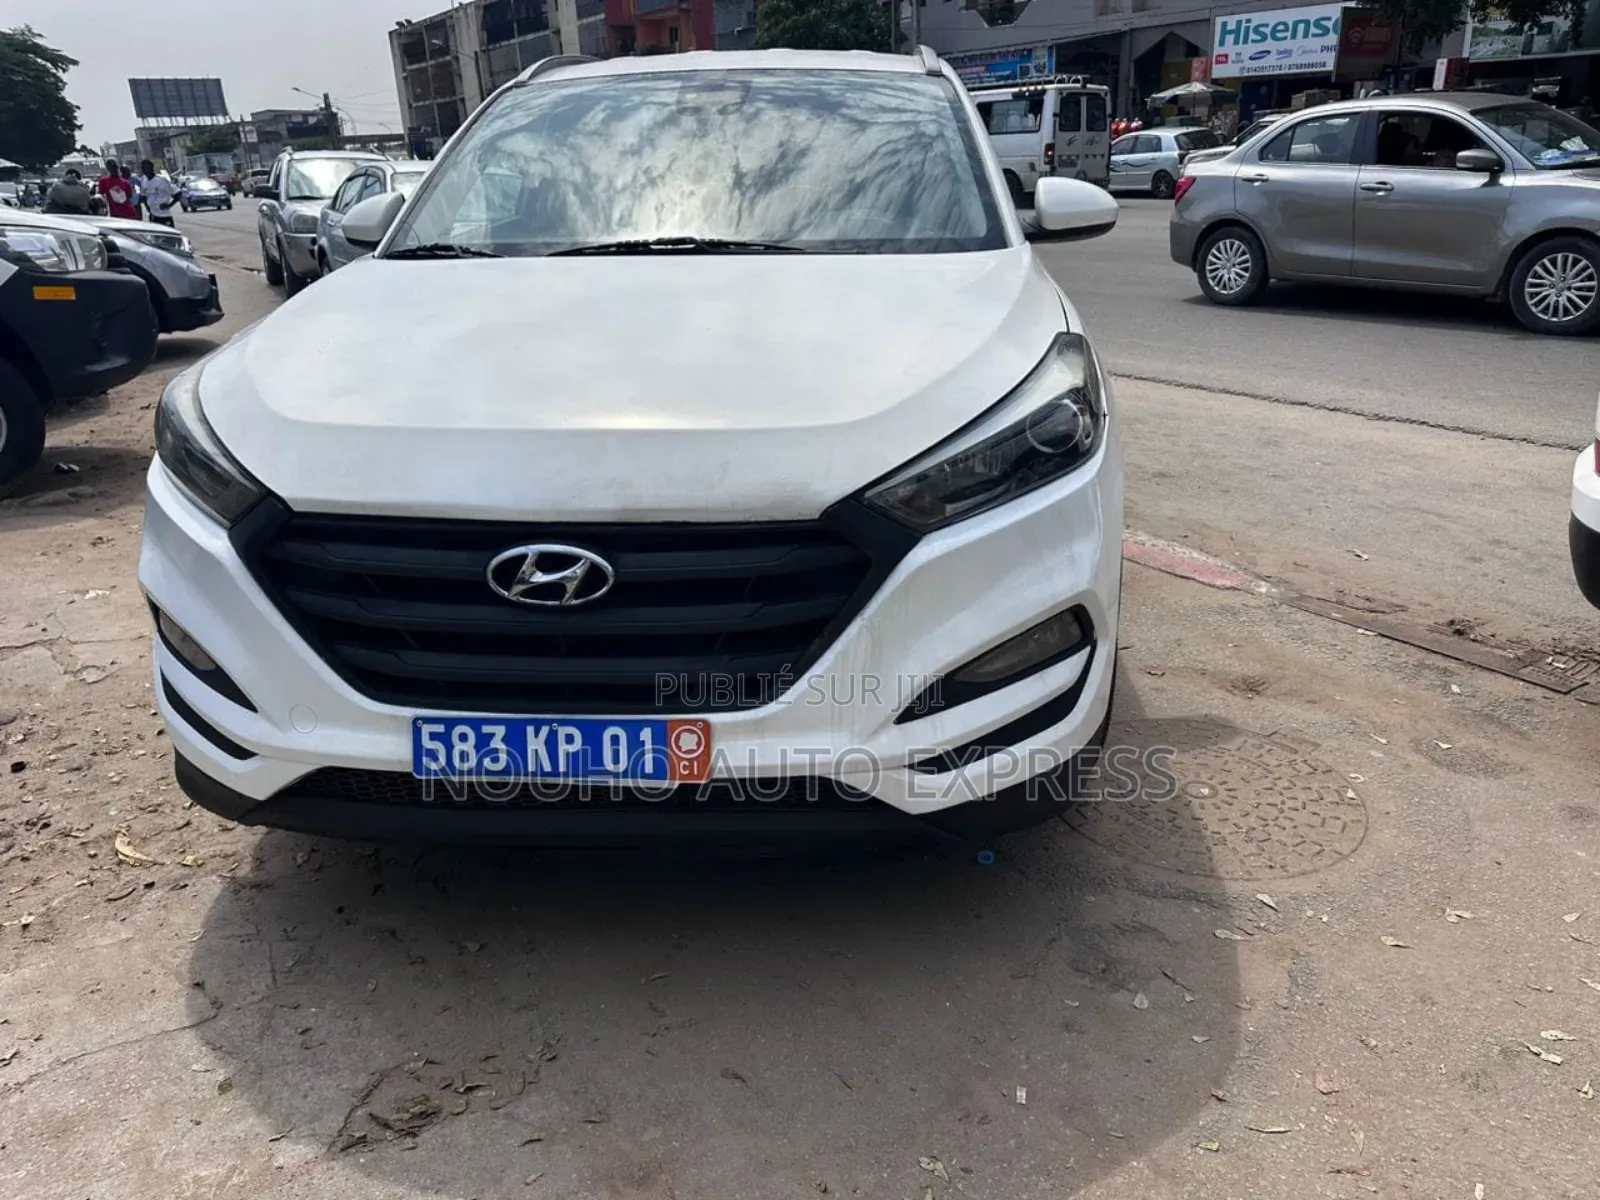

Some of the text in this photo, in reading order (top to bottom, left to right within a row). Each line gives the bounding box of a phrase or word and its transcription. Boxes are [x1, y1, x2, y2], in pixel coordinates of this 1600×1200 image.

[420, 723, 654, 774] 583 KP 01
[679, 760, 698, 775] CI
